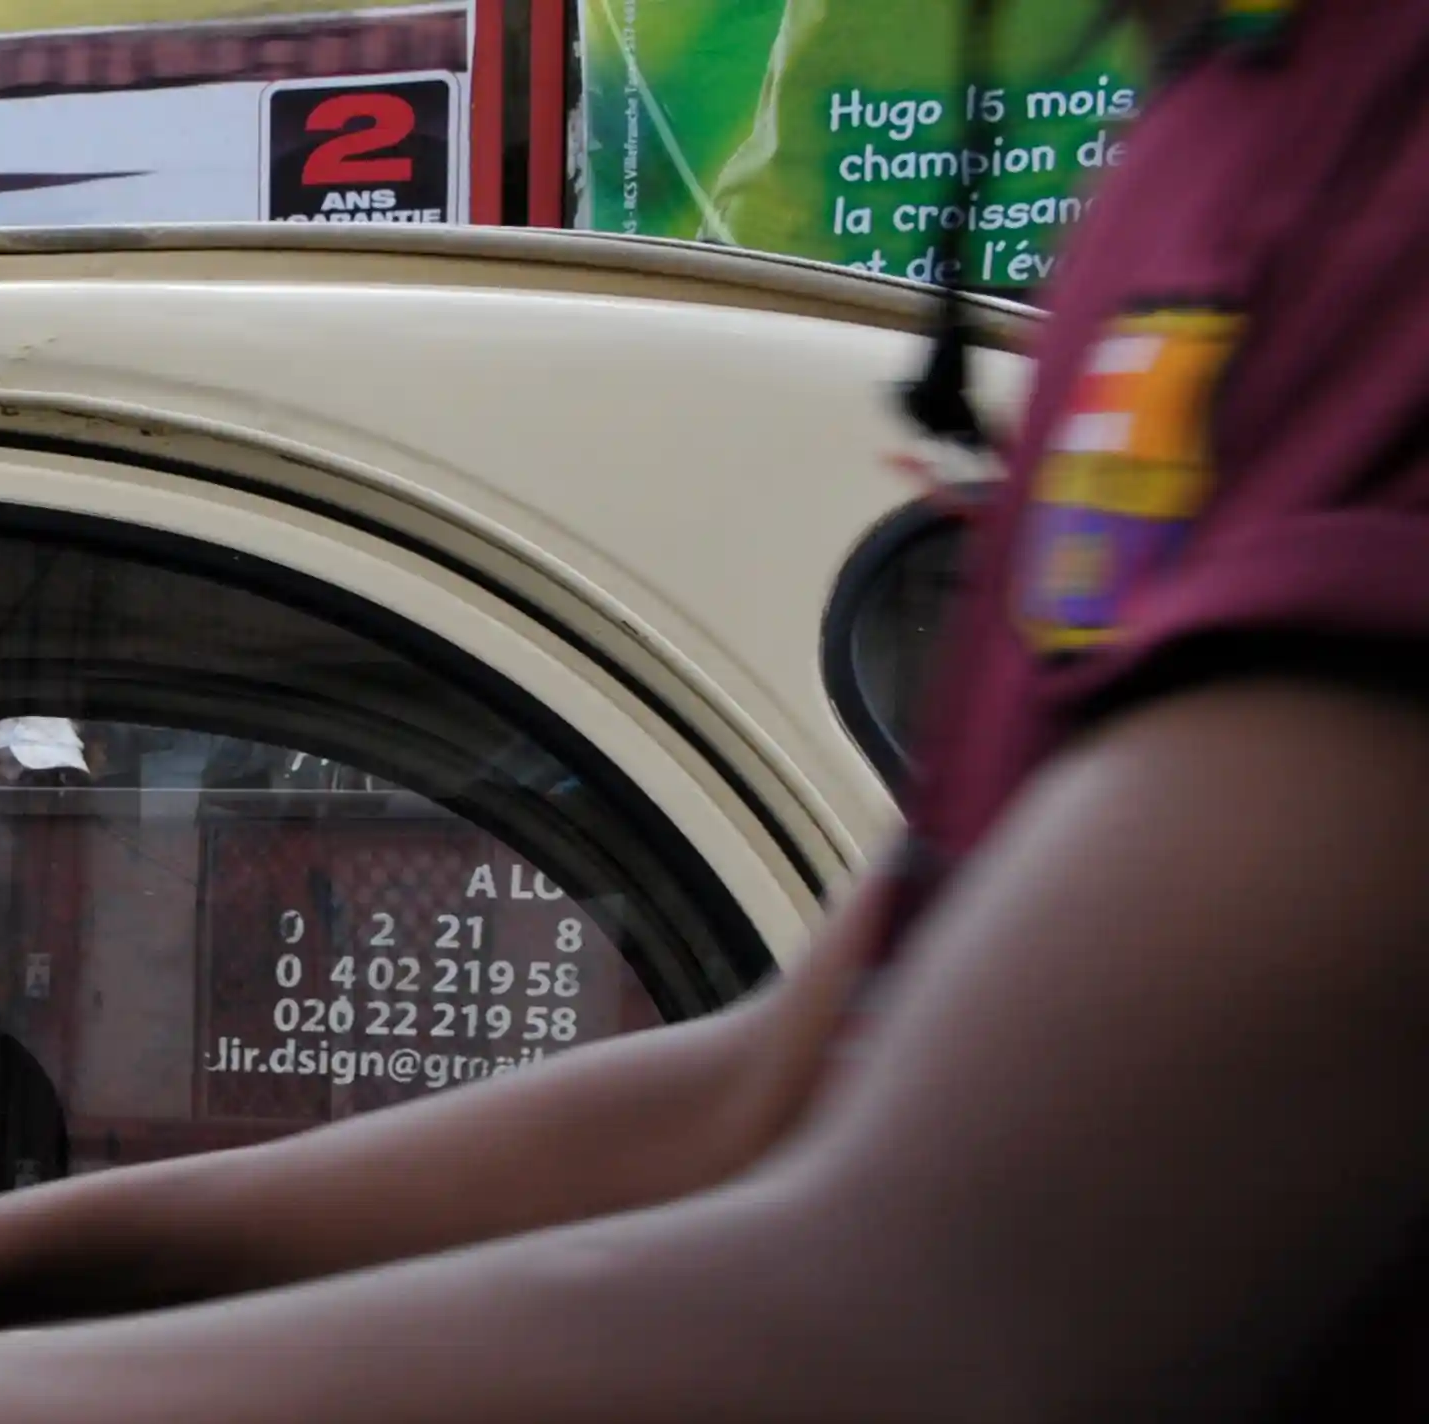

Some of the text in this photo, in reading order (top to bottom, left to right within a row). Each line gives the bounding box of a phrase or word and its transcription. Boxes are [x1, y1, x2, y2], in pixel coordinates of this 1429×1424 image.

[830, 75, 1135, 141] Hugo 15 mois
[301, 93, 415, 184] 2
[840, 136, 1055, 185] champion
[321, 189, 396, 211] ANS
[834, 192, 1094, 234] la croissan
[906, 246, 961, 284] de
[466, 864, 497, 898] A
[556, 918, 582, 952] 8
[368, 958, 420, 992] 02
[433, 960, 515, 994] 219
[526, 962, 580, 997] 58
[274, 998, 577, 1041] 020 22 219 58
